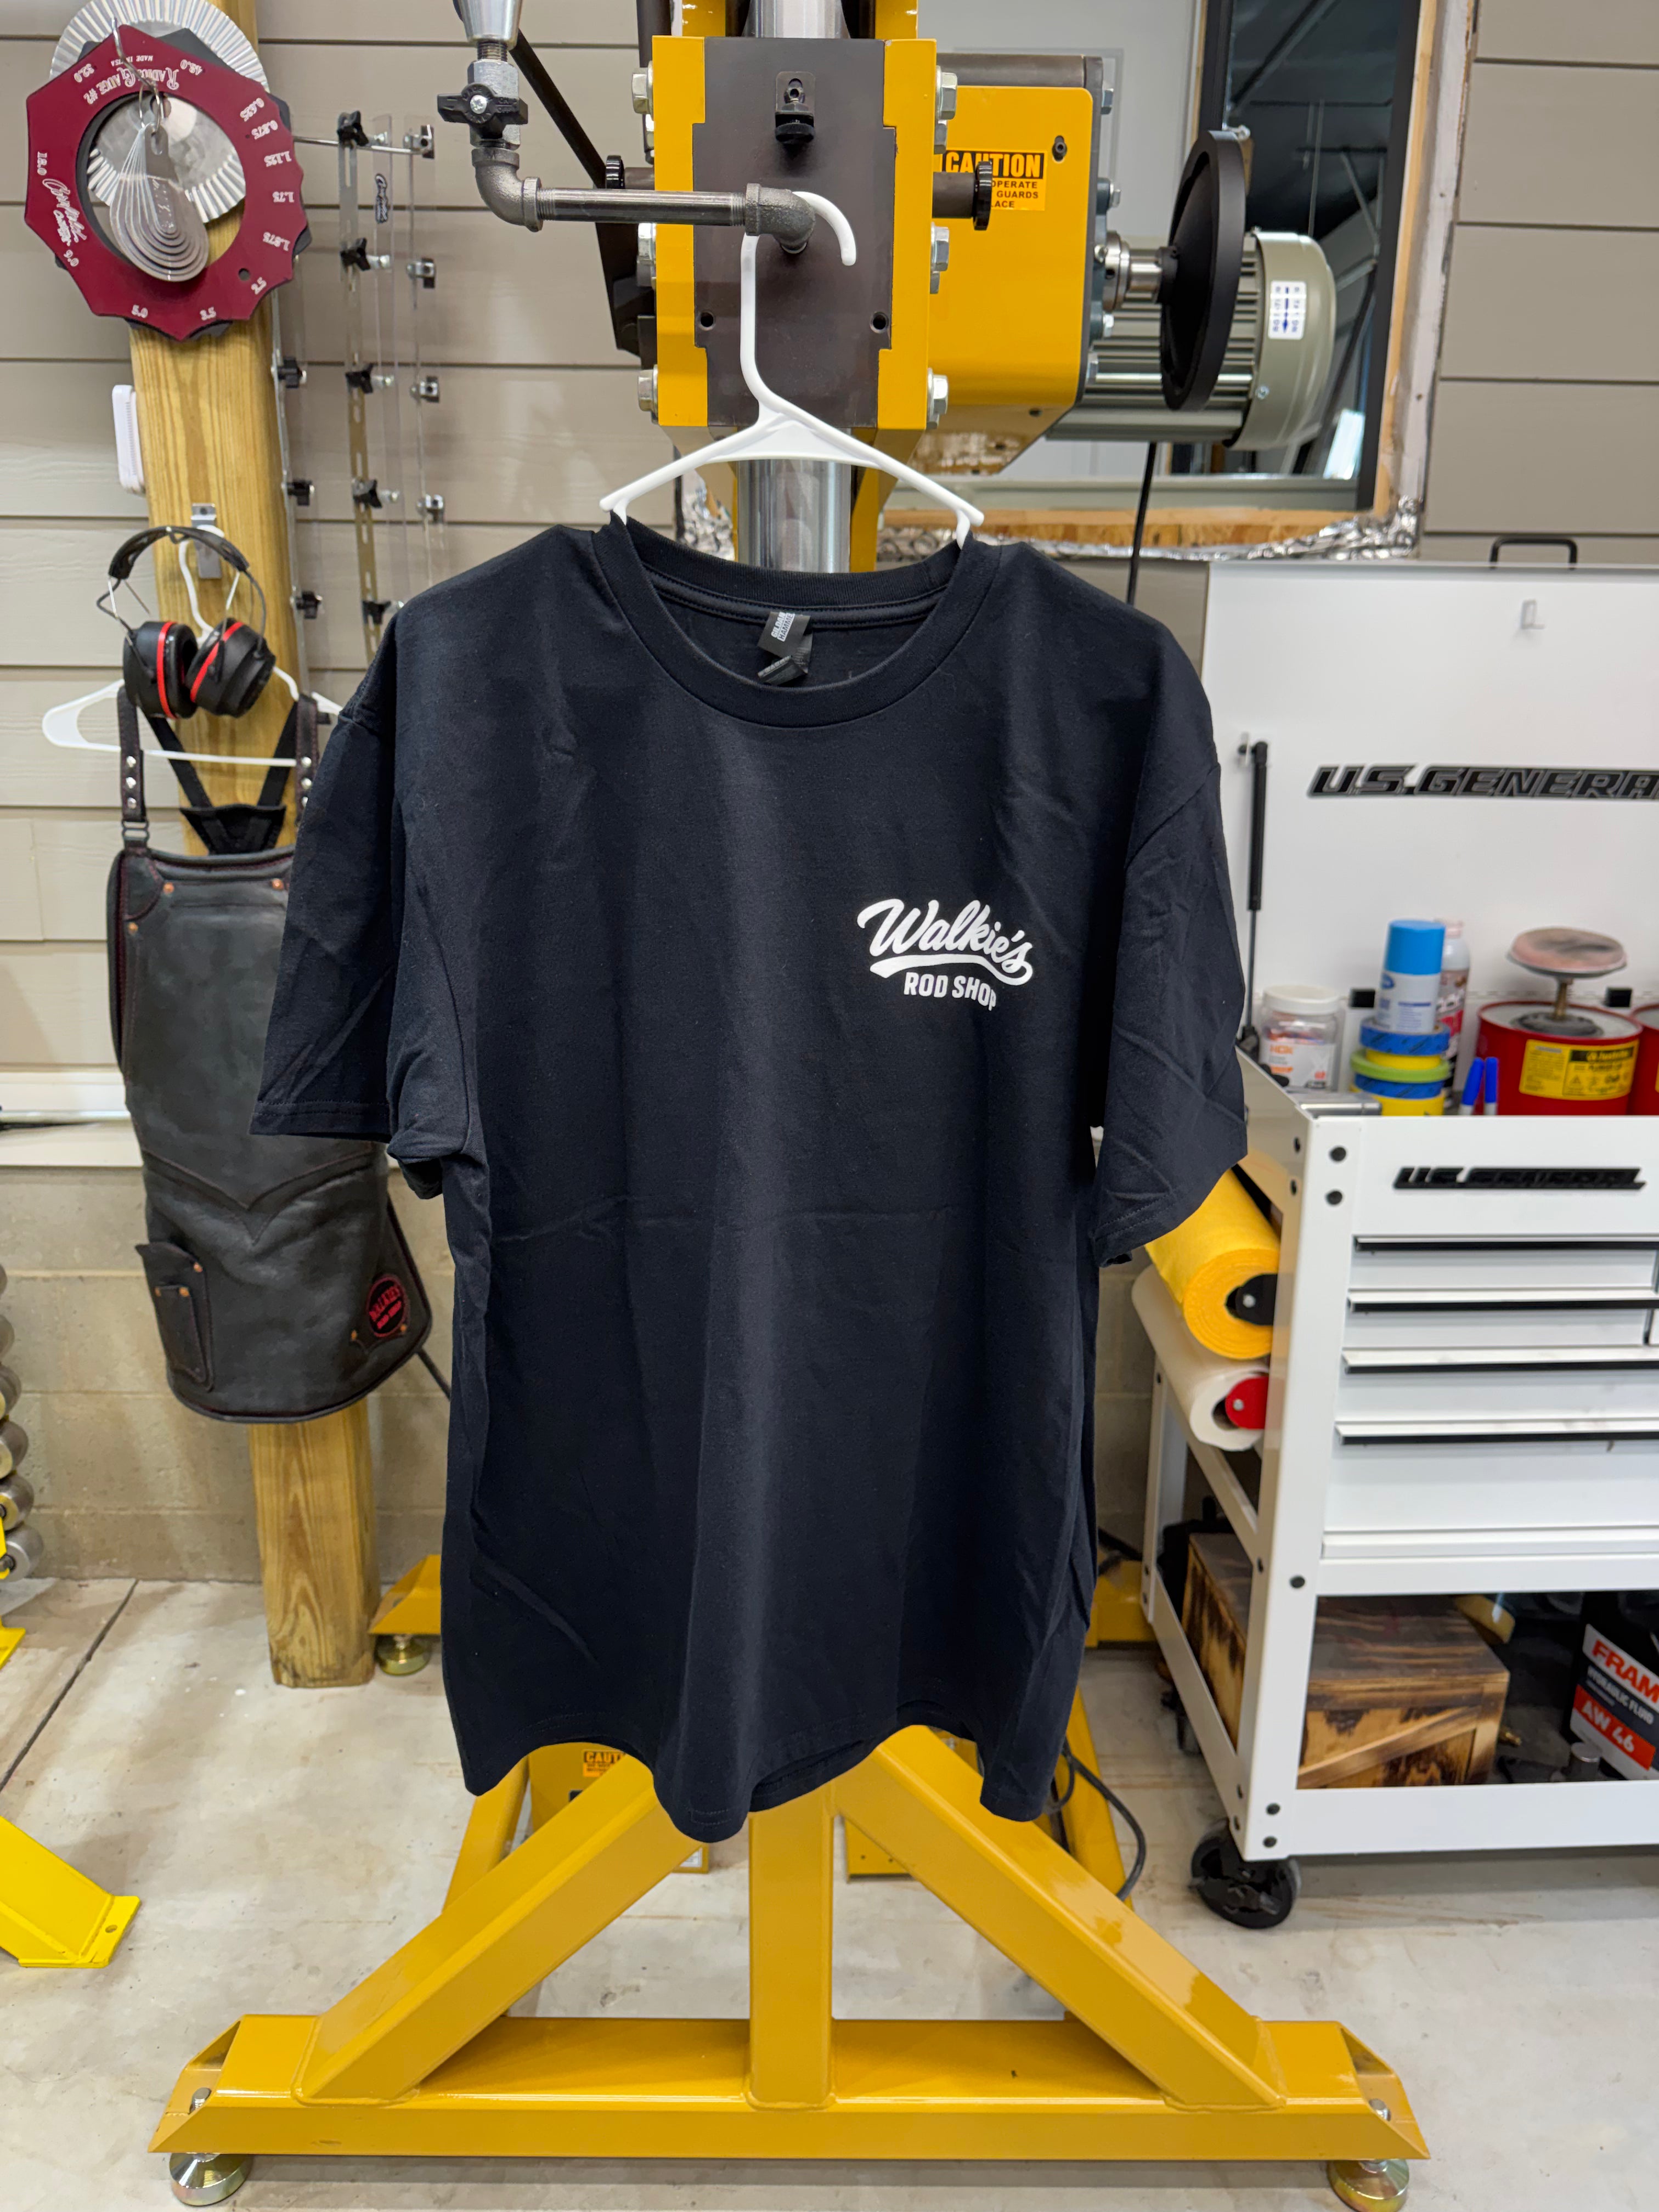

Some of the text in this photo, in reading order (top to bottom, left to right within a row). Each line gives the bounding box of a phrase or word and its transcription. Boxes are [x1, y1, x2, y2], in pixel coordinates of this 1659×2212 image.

[96, 67, 136, 95] GAUGE
[83, 88, 98, 104] #2
[240, 98, 264, 122] 0.625
[251, 120, 278, 140] 0.875
[264, 151, 292, 167] 1.125
[272, 191, 295, 202] 1.75
[997, 190, 1038, 199] GUARDS
[64, 250, 79, 267] 9.0
[251, 276, 267, 295] 2.5
[131, 304, 148, 318] 5.0
[771, 611, 786, 638] GILDAN
[778, 613, 794, 640] HAMME
[857, 898, 1033, 974] Walkie's
[904, 972, 997, 1011] ROD SHOP
[1592, 1639, 1659, 1703] FRAM
[1581, 1700, 1635, 1753] AW 46
[586, 1751, 623, 1763] CAUT
